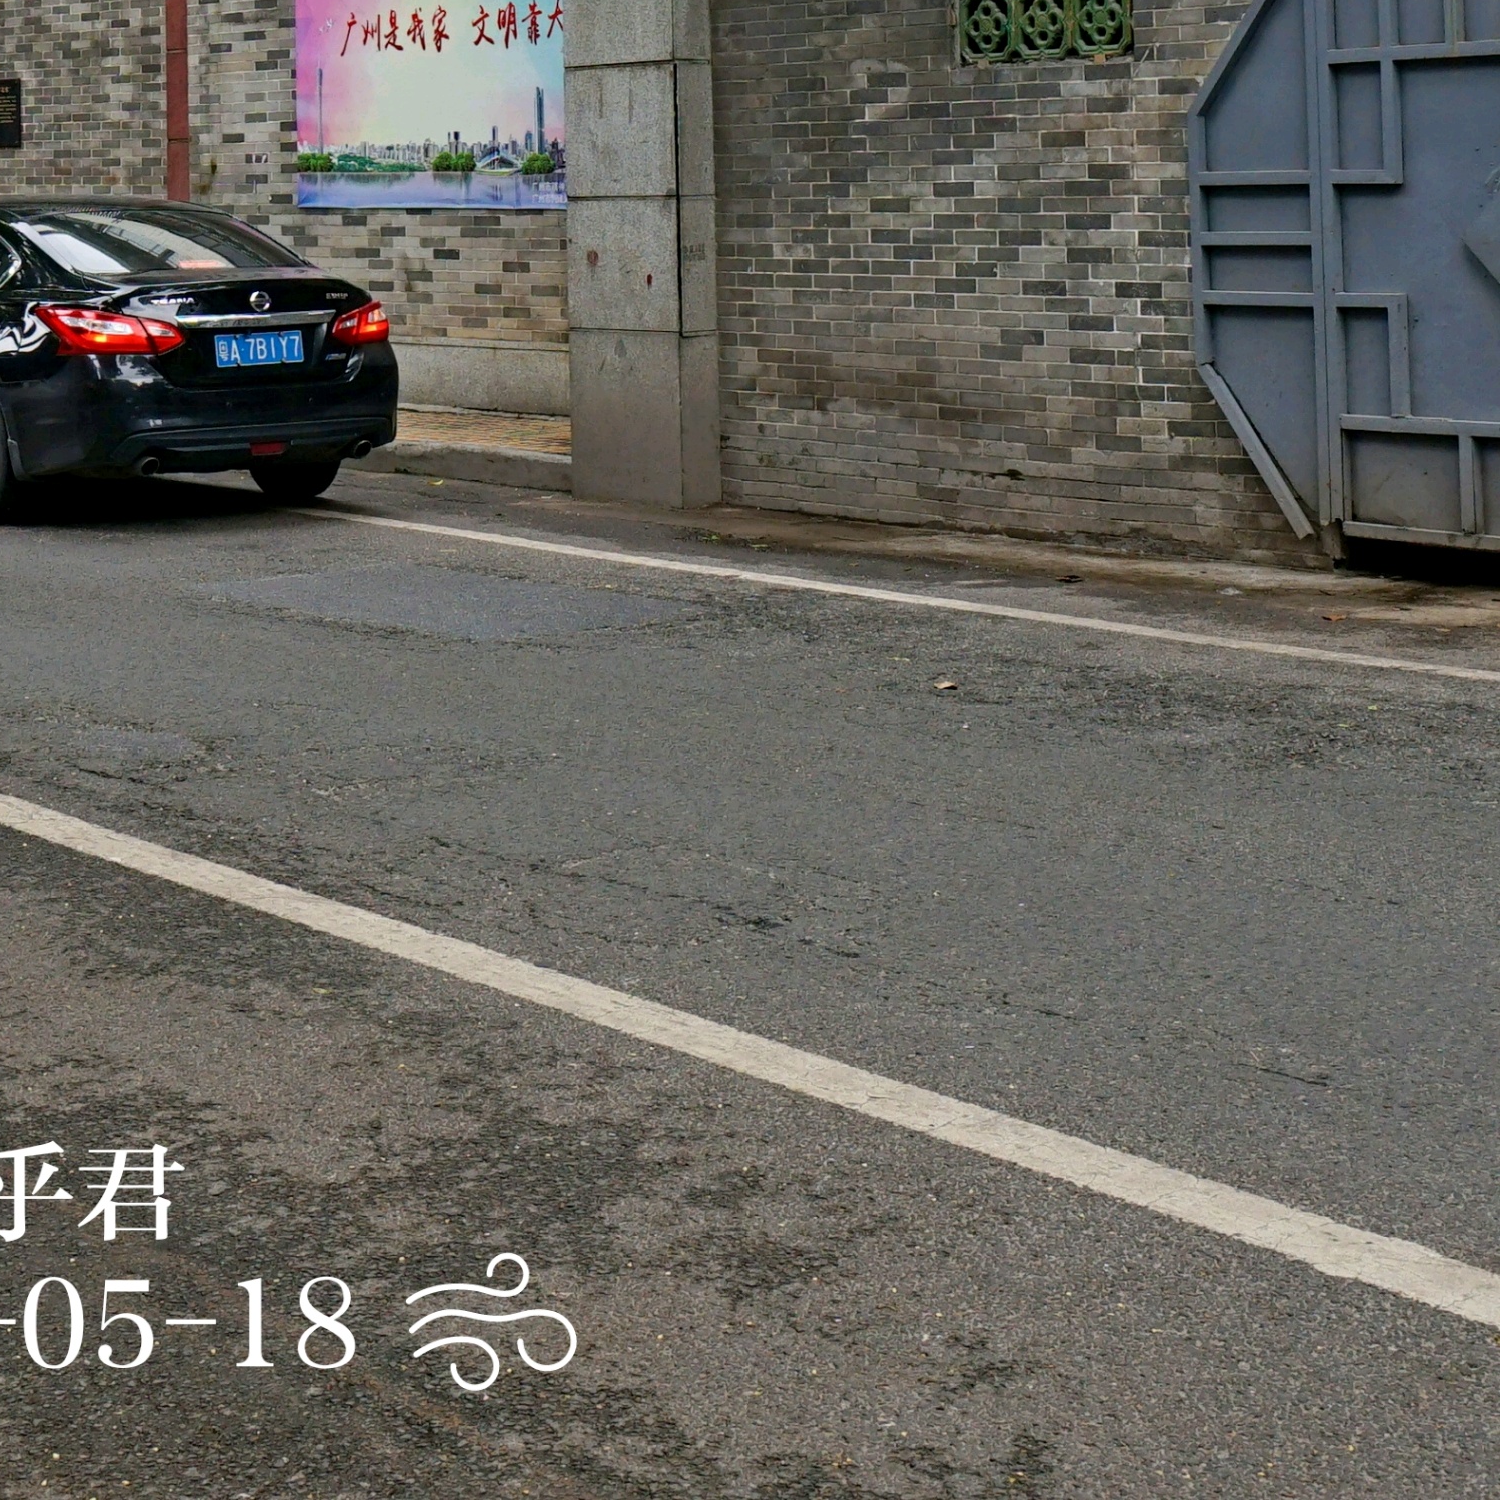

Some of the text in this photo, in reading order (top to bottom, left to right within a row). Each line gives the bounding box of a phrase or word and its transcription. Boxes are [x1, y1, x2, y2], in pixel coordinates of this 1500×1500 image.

[341, 5, 450, 57] 广州是我家
